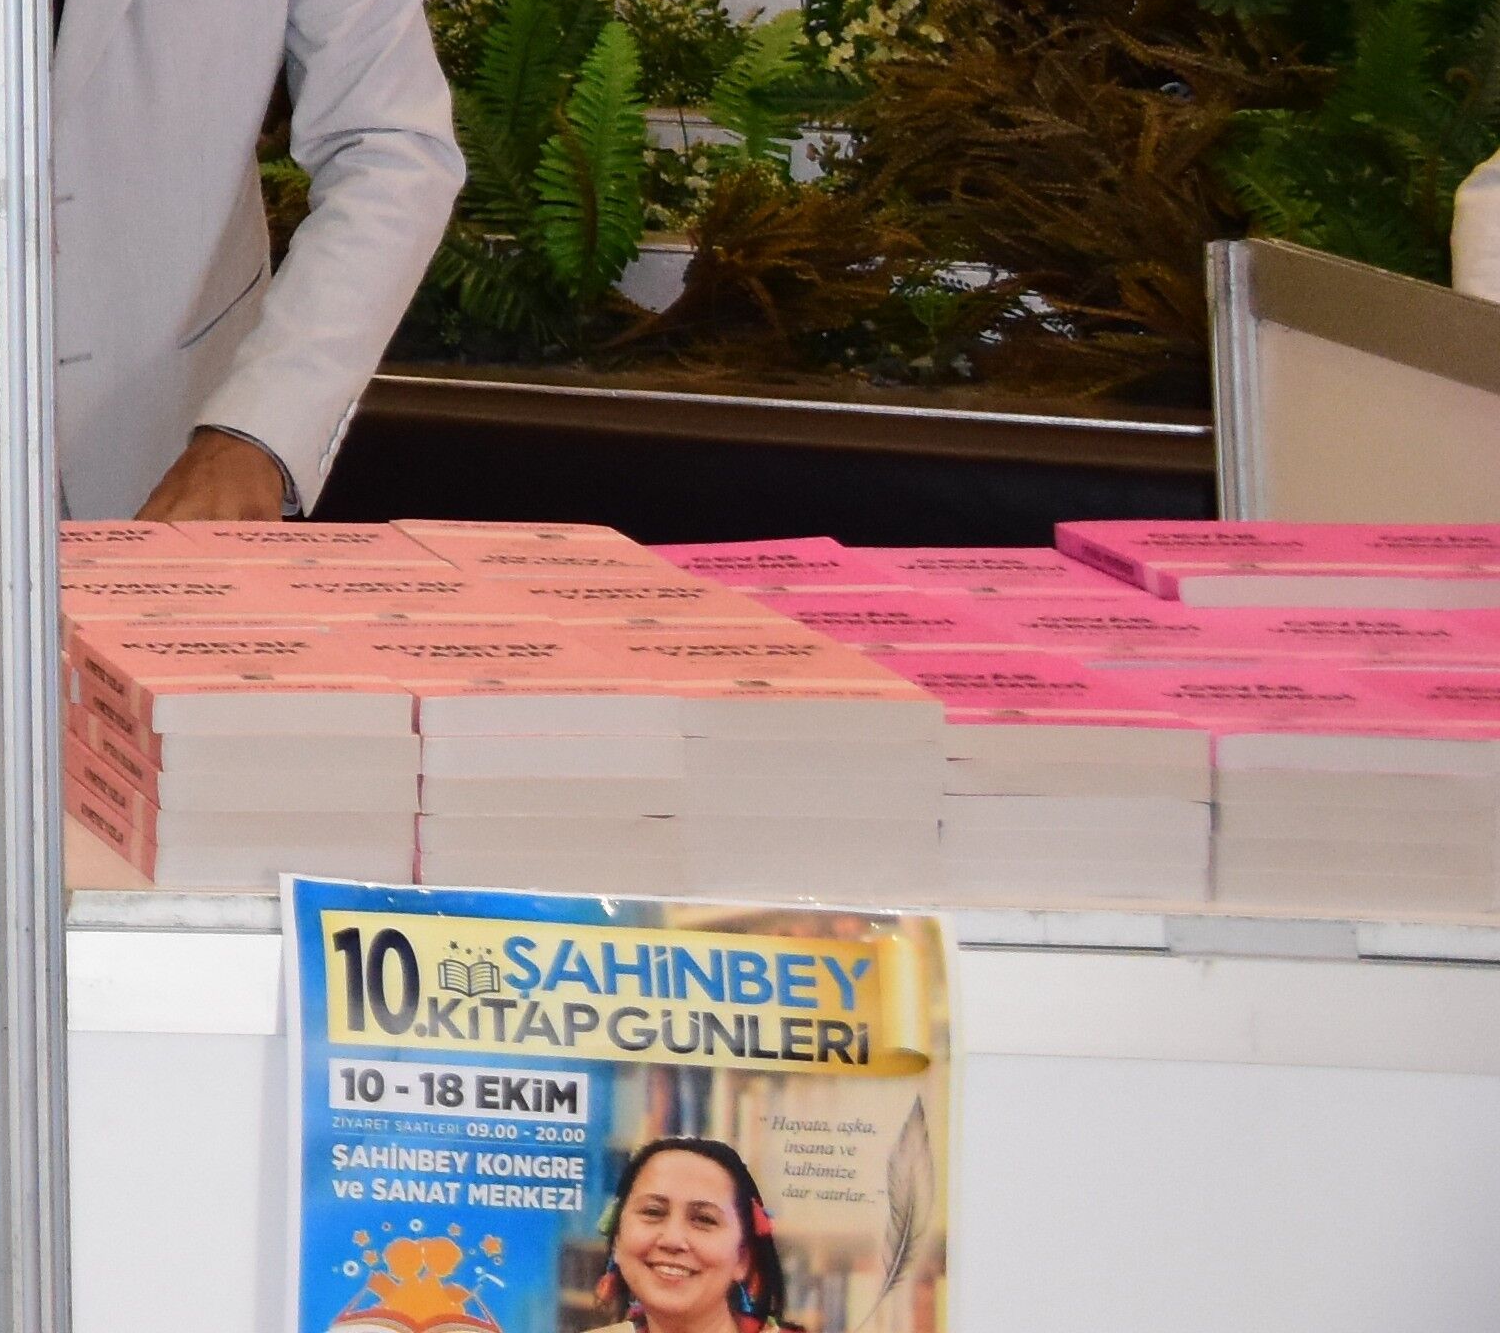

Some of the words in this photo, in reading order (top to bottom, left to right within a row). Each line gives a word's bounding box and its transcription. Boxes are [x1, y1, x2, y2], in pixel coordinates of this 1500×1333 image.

[340, 1066, 385, 1103] 10
[418, 1071, 465, 1108] 18
[466, 1122, 519, 1140] 09.00
[534, 1126, 587, 1144] 20.00
[332, 1142, 470, 1175] ŞAHİNBEY
[476, 1151, 585, 1180] KONGRE
[332, 1180, 365, 1200] ve
[371, 1178, 461, 1205] SANAT
[467, 1183, 584, 1211] MERKEZİ
